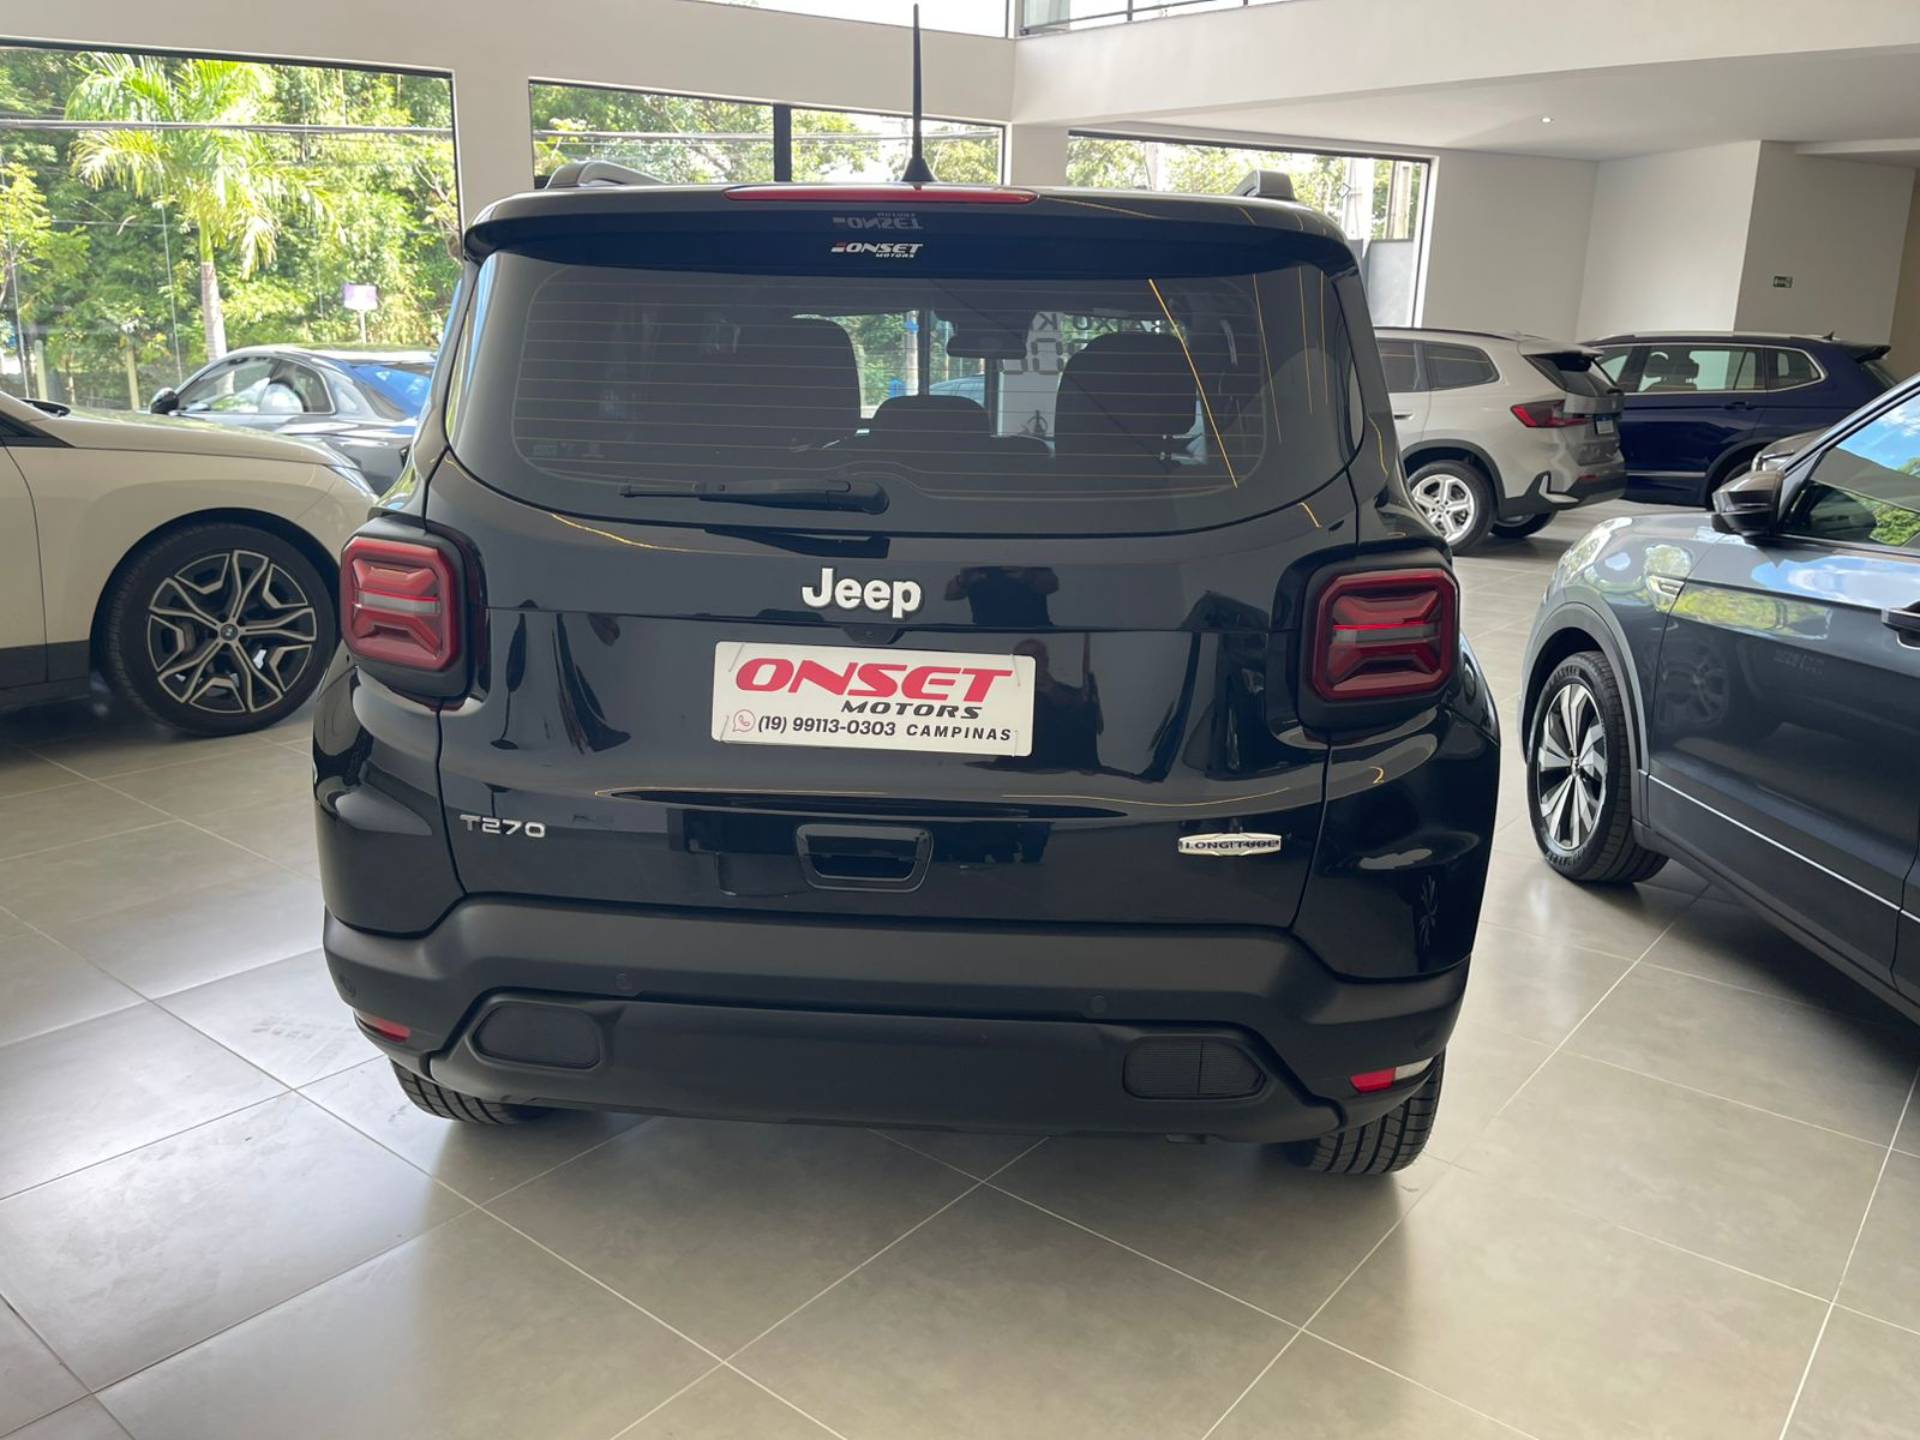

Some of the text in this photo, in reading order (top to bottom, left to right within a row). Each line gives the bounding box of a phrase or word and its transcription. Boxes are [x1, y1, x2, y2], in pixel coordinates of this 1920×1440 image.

[846, 242, 924, 253] ONSET
[802, 567, 921, 619] Jeep
[736, 657, 1013, 703] ONSET
[841, 700, 983, 720] MOTORS
[758, 715, 1012, 741] (19) 99113-0303 CAMPINAS
[460, 814, 545, 838] T270
